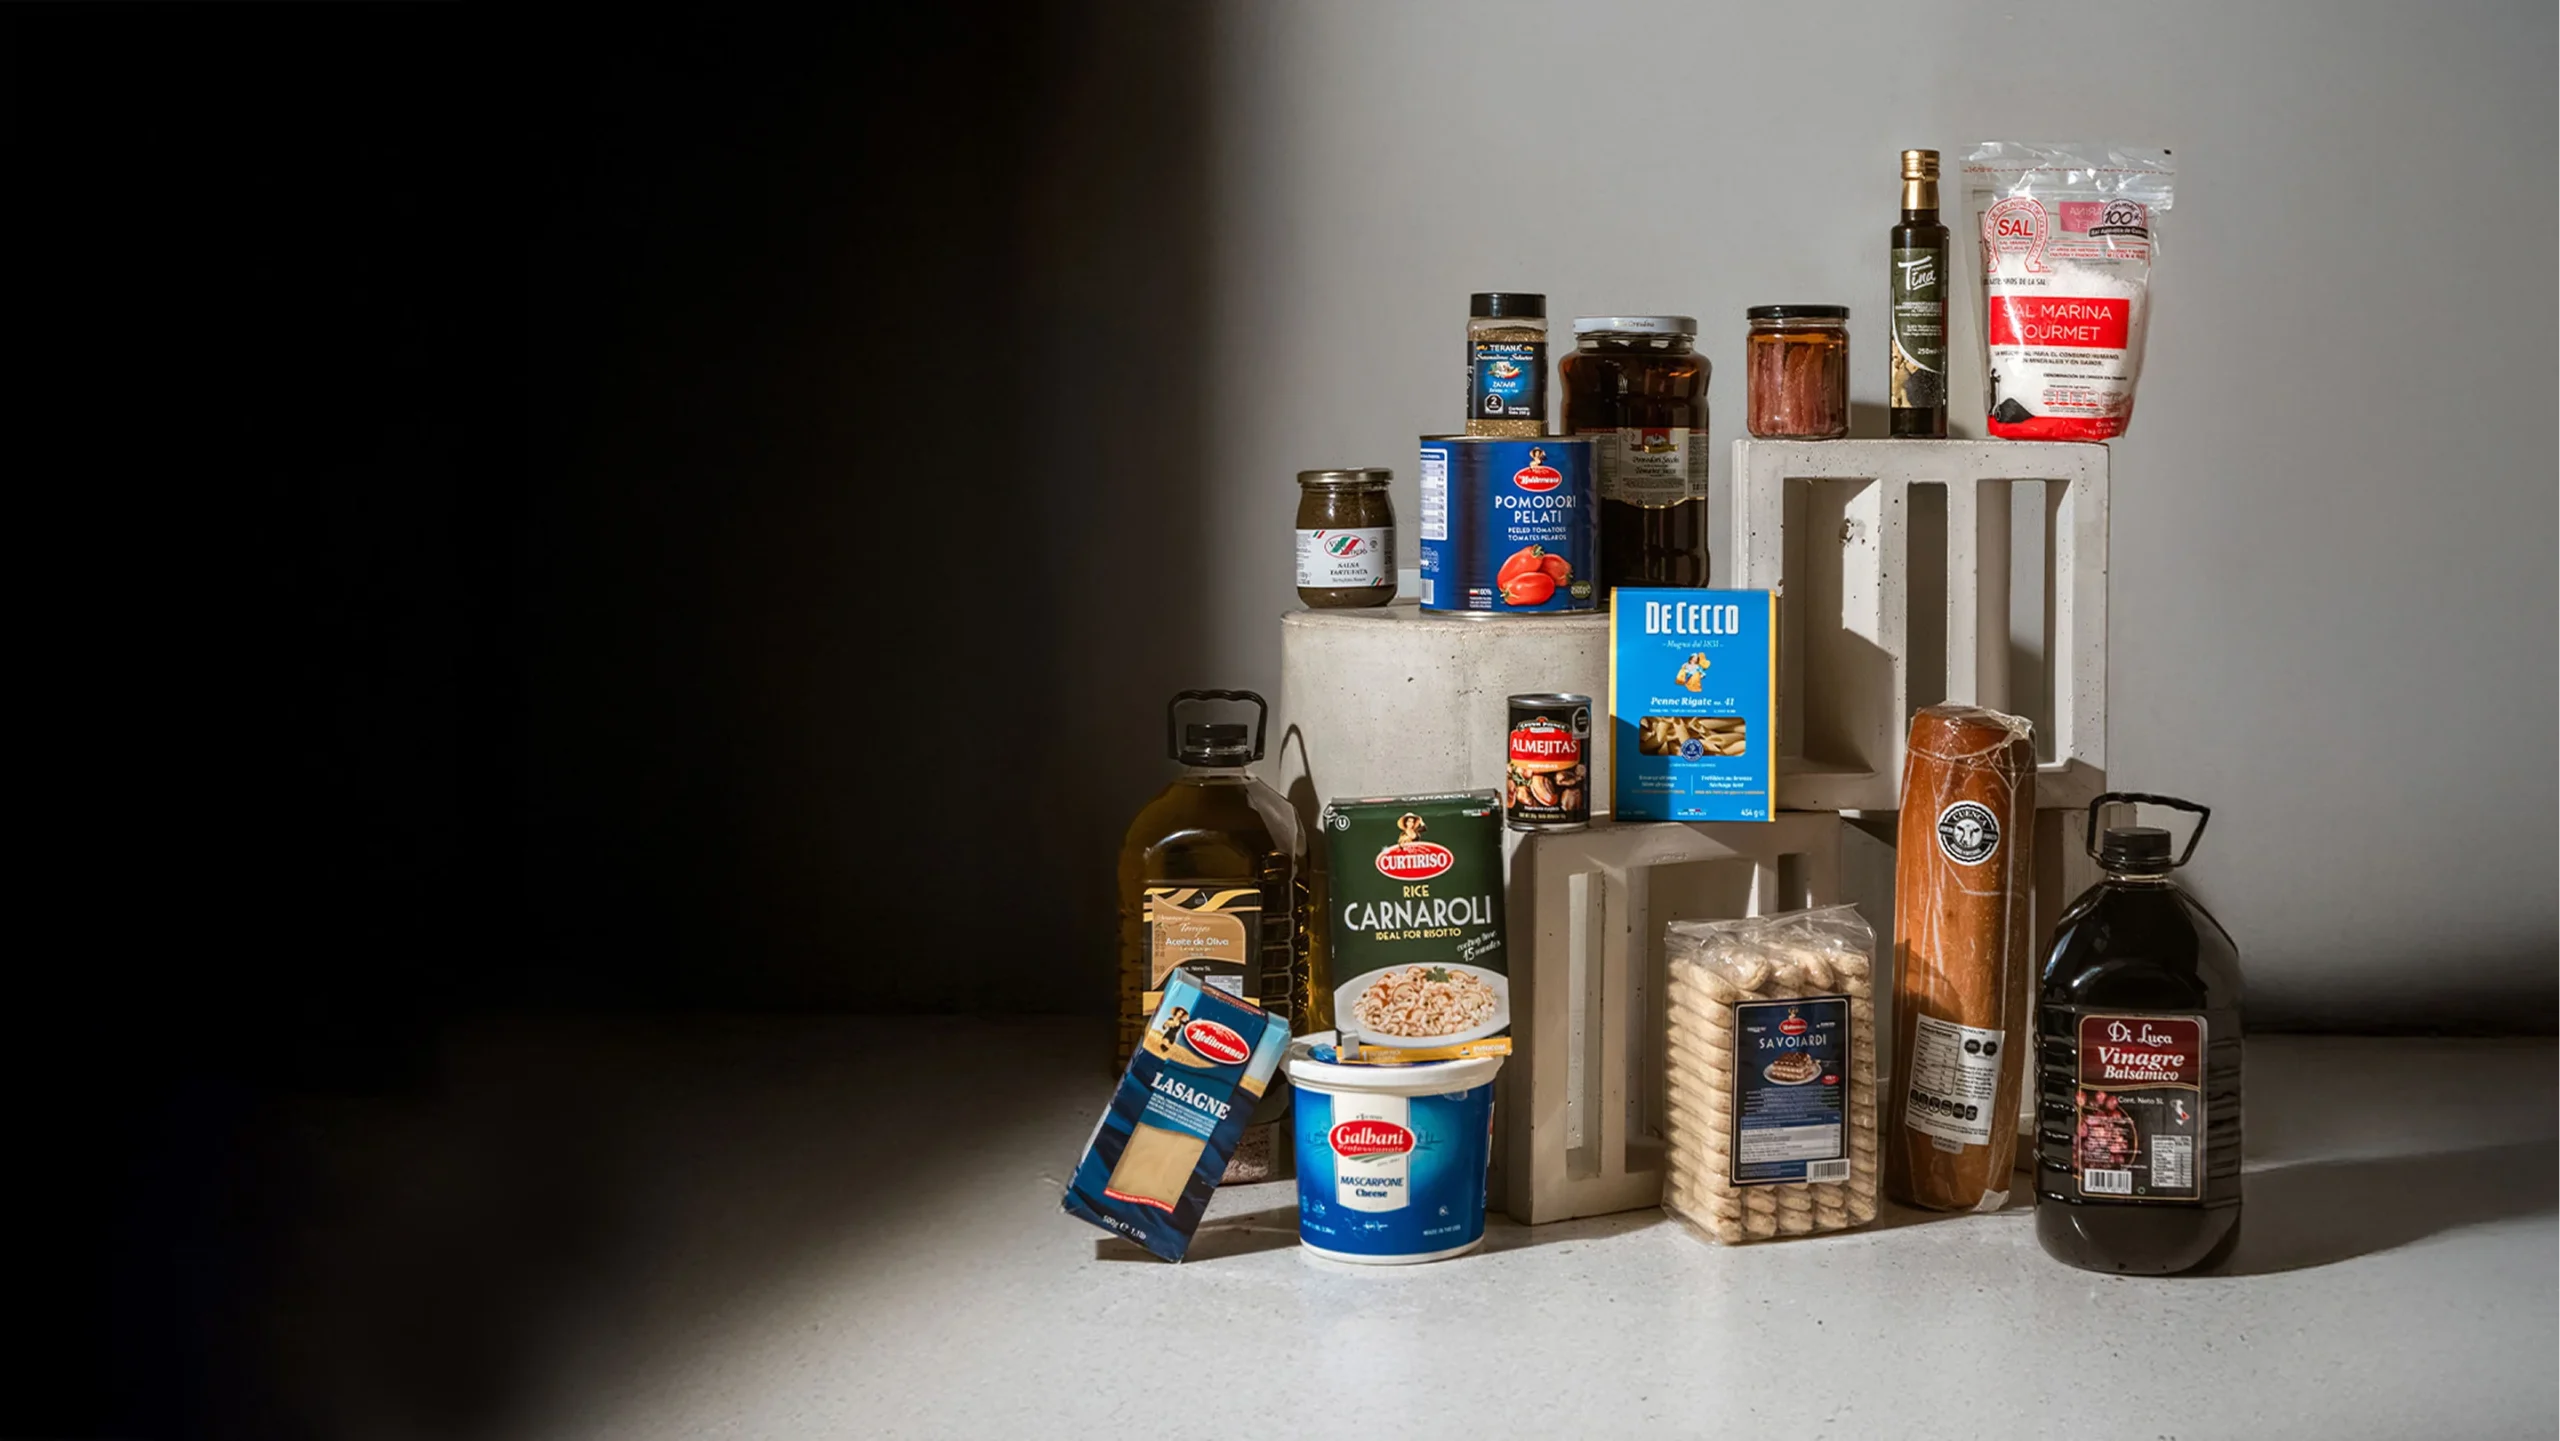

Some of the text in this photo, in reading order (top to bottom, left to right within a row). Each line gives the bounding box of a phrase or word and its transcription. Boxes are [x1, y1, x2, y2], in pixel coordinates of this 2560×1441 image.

[1998, 219, 2034, 236] SAL
[1898, 255, 1937, 291] Tina
[2040, 303, 2113, 321] MARINA
[1491, 396, 1498, 405] 2
[1495, 495, 1576, 509] POMODORI
[1514, 510, 1562, 524] PELATI
[1646, 602, 1739, 635] DE CECCO
[1651, 697, 1680, 706] Penne
[1681, 696, 1712, 708] Rigate
[1724, 697, 1735, 706] 41
[1512, 739, 1578, 756] ALMEJITAS
[1380, 853, 1448, 871] CURTIRISO
[1402, 884, 1430, 899] RICE
[1344, 895, 1492, 932] CARNAROLI
[1193, 937, 1204, 946] de
[1206, 937, 1229, 946] Oliva
[1375, 927, 1462, 942] IDEAL FOR RISOTTO
[1463, 947, 1475, 962] 15
[1759, 1034, 1827, 1050] SAVOIARDI
[2107, 1020, 2173, 1047] Di Luca
[2097, 1046, 2185, 1070] Vinagre
[2103, 1064, 2179, 1081] Balsámico
[1151, 1072, 1232, 1121] LASAGNE
[1336, 1125, 1405, 1146] Galbani
[1340, 1176, 1405, 1188] MASCARPONE
[1355, 1188, 1388, 1198] Cheese
